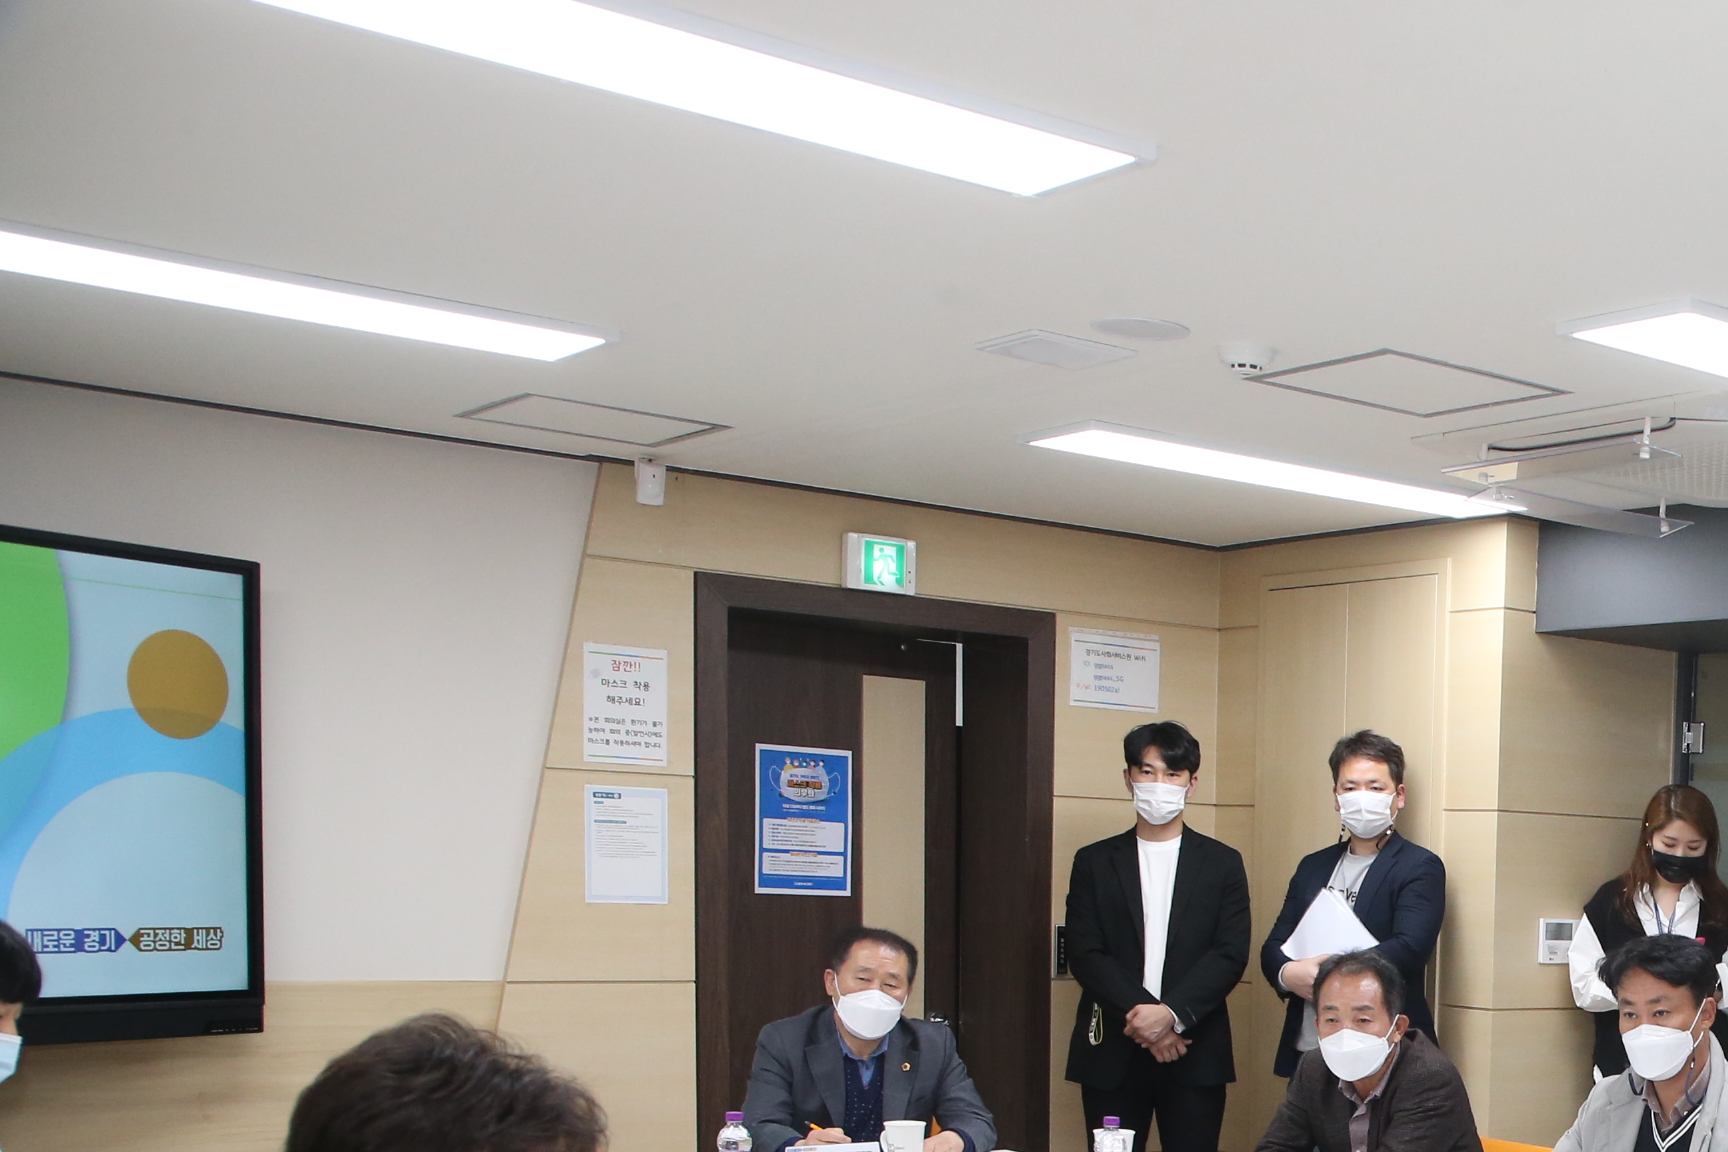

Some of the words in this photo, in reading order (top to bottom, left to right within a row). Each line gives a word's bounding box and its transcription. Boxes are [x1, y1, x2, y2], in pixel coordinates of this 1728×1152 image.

[611, 659, 642, 673] 잠깐!!
[601, 678, 628, 689] 마스크
[633, 681, 651, 692] 착용
[606, 695, 645, 706] 해주세요!
[84, 930, 115, 952] 경기
[140, 929, 186, 950] 공정한
[192, 929, 223, 950] 세상
